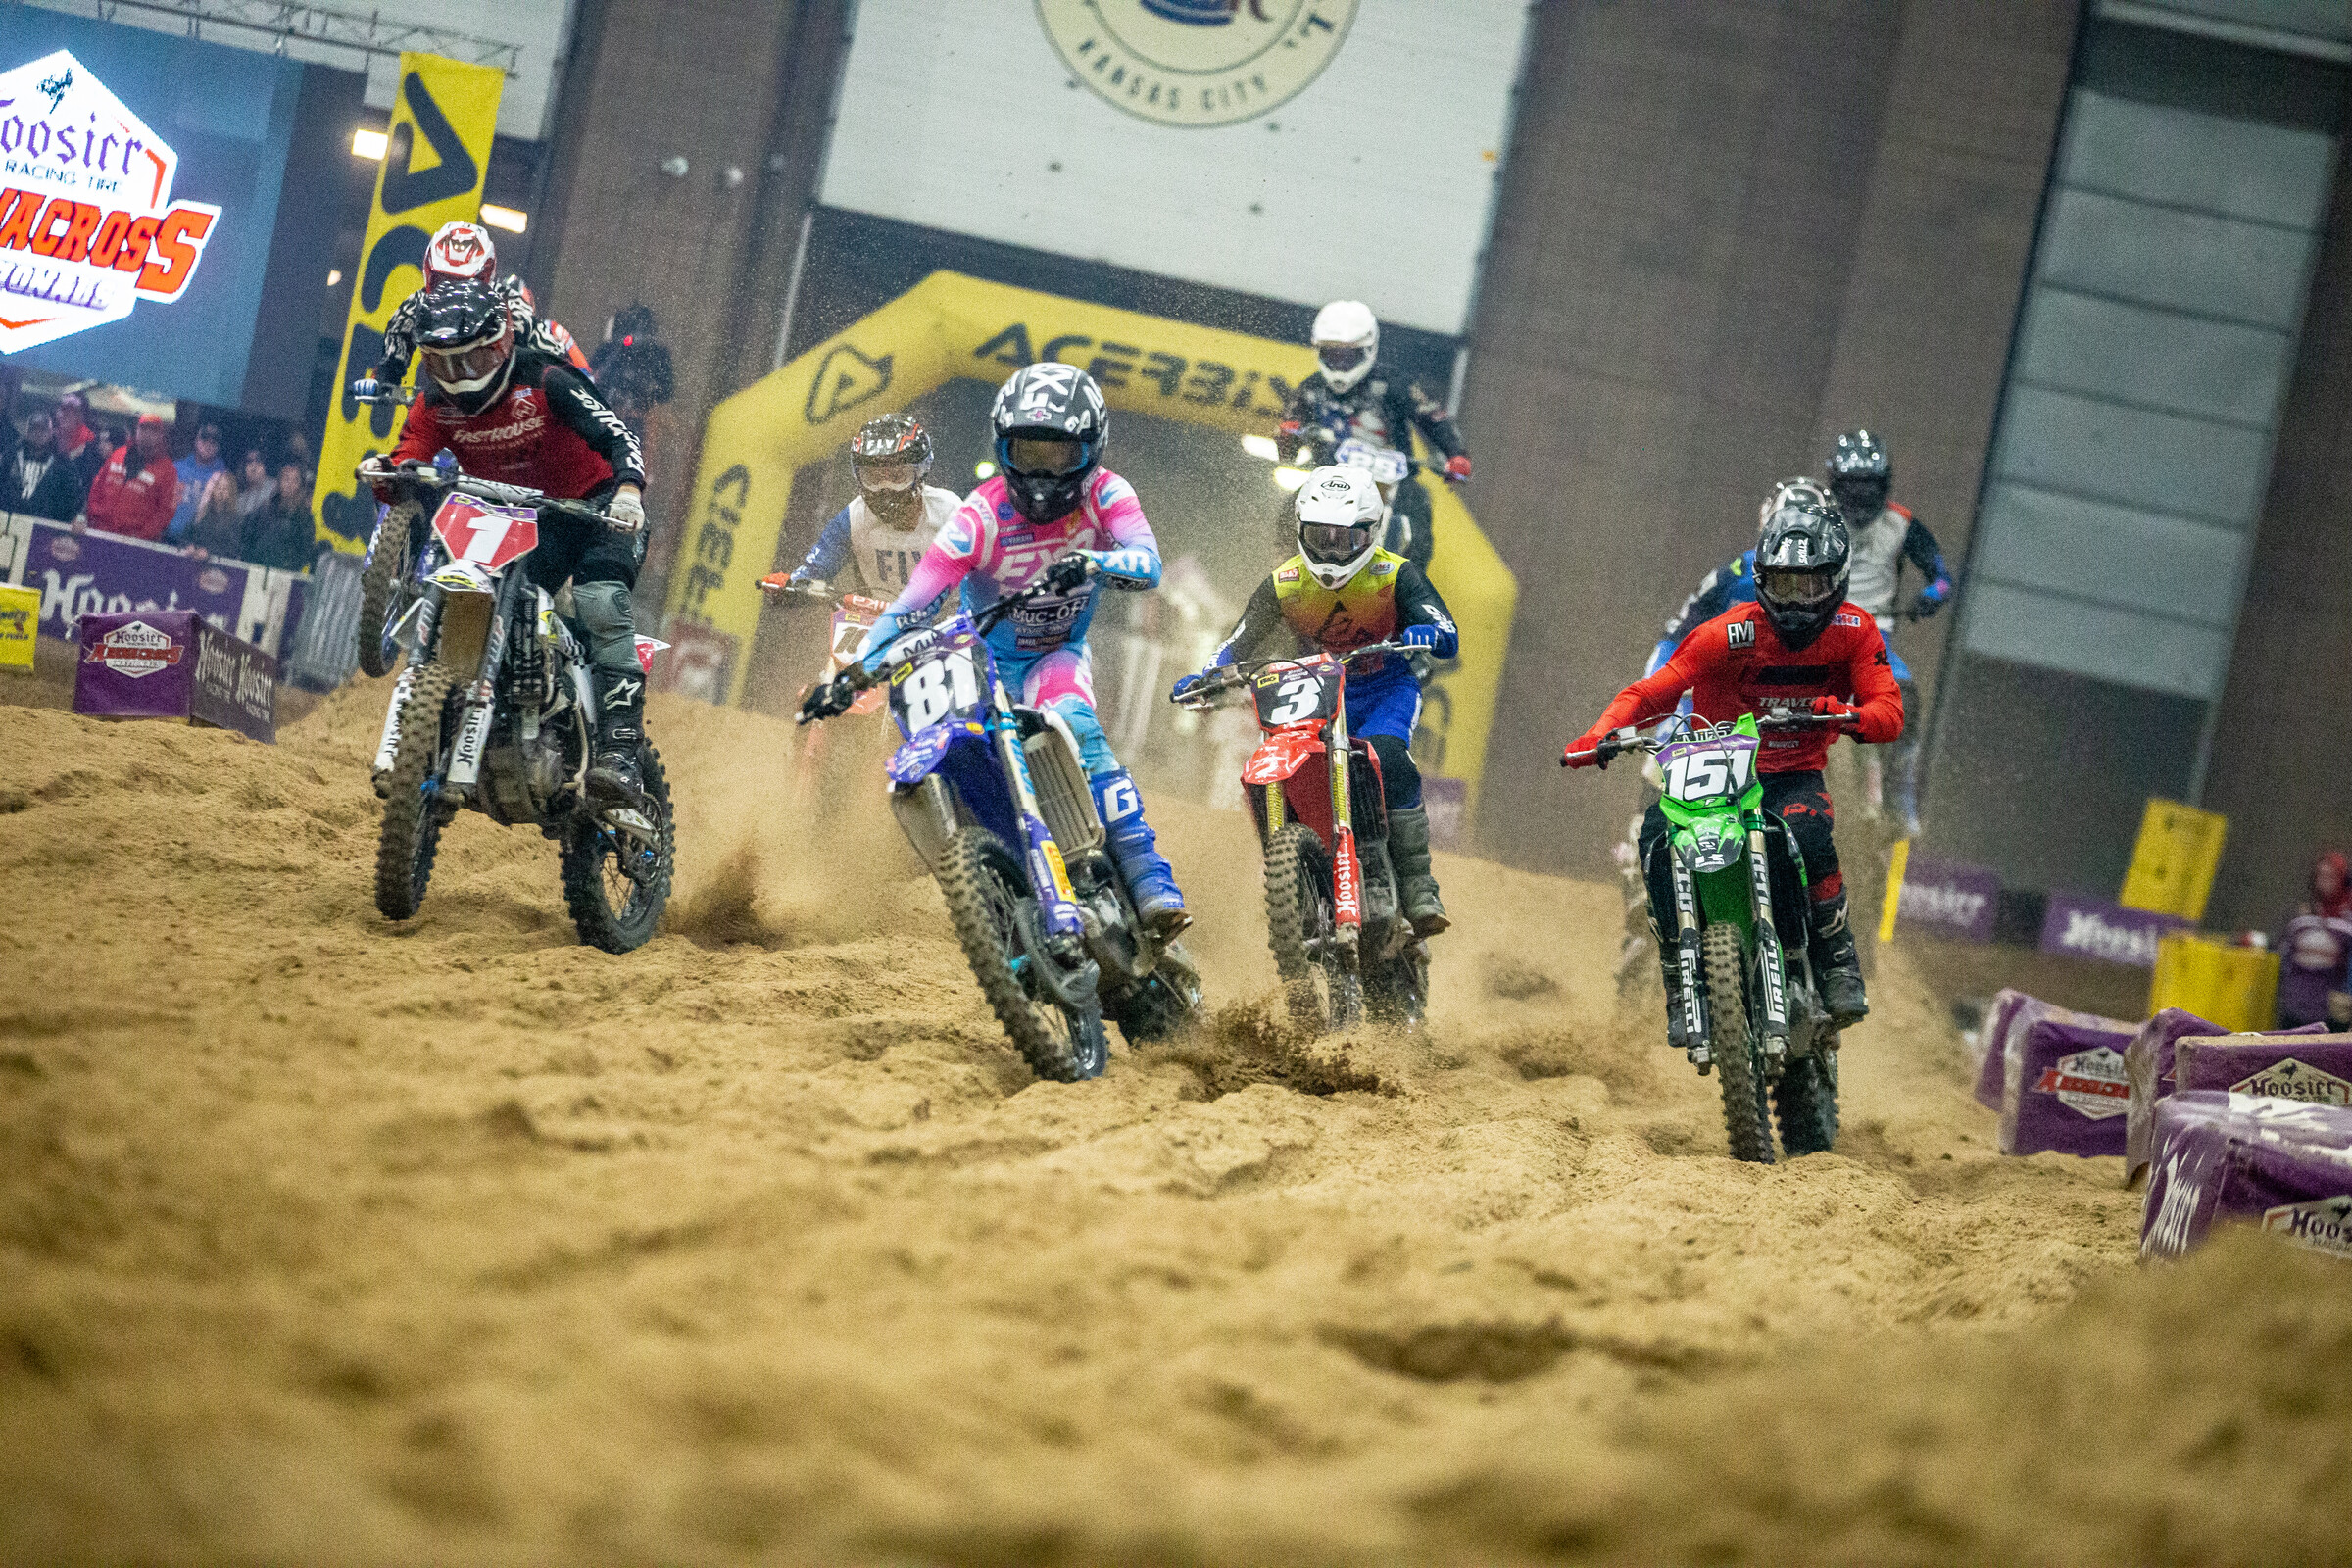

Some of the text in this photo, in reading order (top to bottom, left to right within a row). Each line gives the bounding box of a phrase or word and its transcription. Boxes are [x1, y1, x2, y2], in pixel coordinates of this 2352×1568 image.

[0, 99, 143, 175] oosier
[5, 160, 77, 185] RACING
[866, 439, 895, 451] FLY
[1328, 480, 1347, 489] Arai
[458, 514, 512, 564] 1
[1099, 550, 1151, 574] XR
[113, 631, 162, 644] Hoosier
[903, 646, 978, 734] 81
[1271, 674, 1325, 725] 3
[457, 708, 481, 771] Hoosier
[1666, 749, 1752, 802] 151
[1334, 850, 1357, 918] Hoosier
[1760, 939, 1786, 1026] PIRELLI
[2250, 1076, 2338, 1098] Hoosier
